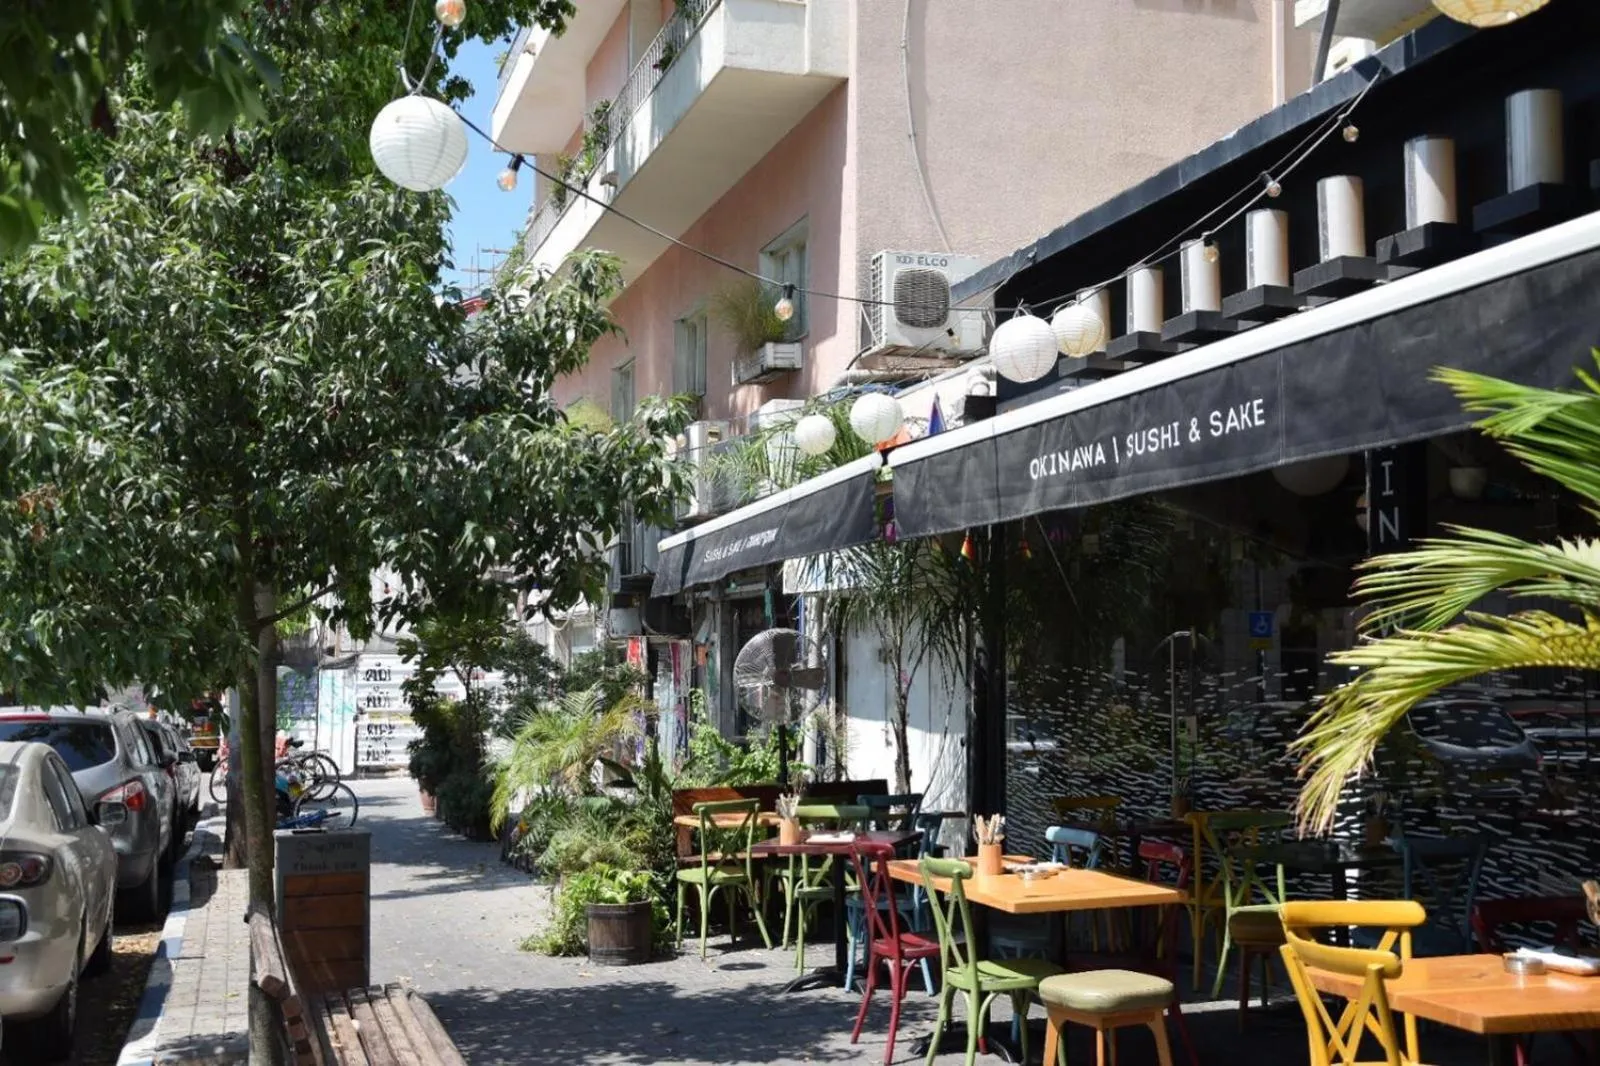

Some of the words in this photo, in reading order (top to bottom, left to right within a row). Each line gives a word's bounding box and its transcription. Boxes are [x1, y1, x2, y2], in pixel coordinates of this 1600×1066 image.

[917, 255, 948, 267] ELCO
[1029, 443, 1106, 480] OKINAWA
[1126, 421, 1181, 458] SUSHI
[1188, 417, 1201, 443] &
[1209, 398, 1266, 437] SAKE
